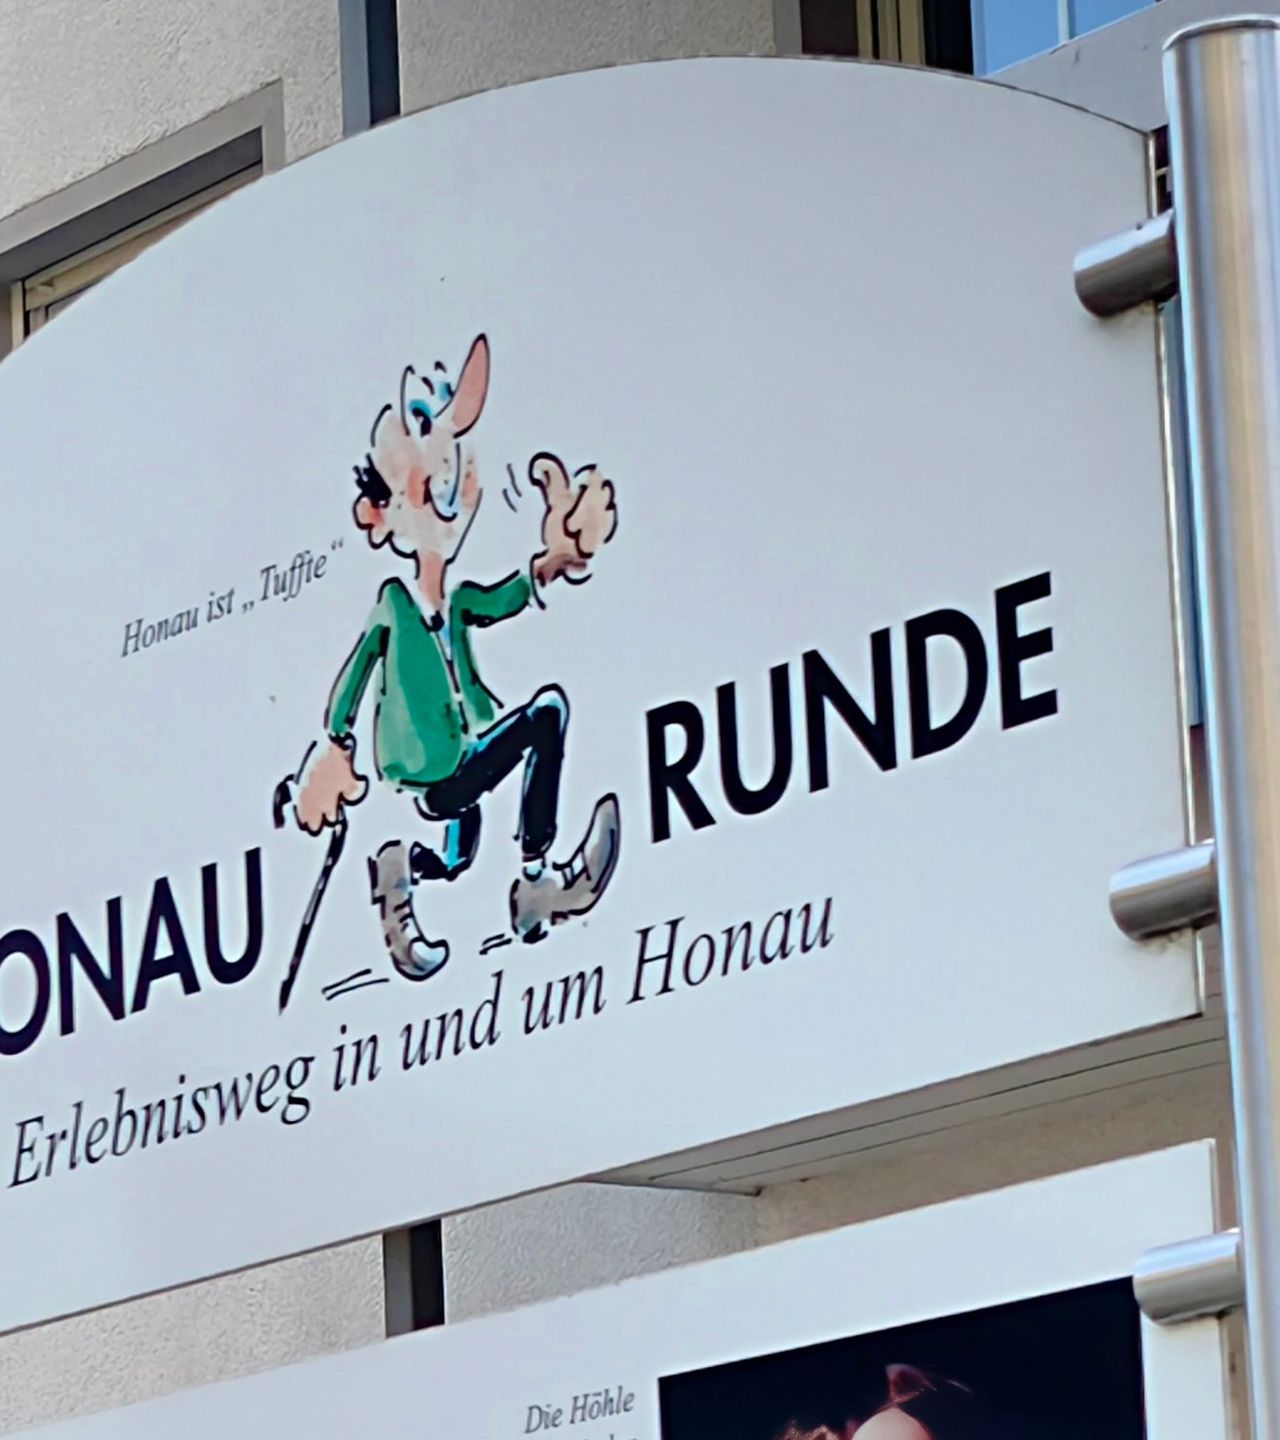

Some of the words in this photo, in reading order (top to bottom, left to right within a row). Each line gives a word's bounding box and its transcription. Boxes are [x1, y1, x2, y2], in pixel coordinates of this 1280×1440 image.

[121, 607, 199, 658] Honau
[206, 587, 235, 623] ist
[645, 571, 1061, 845] RUNDE
[8, 1053, 316, 1190] Erlebnisweg
[330, 1023, 381, 1093] in
[400, 970, 502, 1071] und
[521, 965, 608, 1038] um
[625, 894, 837, 1007] Honau
[524, 1403, 563, 1434] Die
[569, 1385, 635, 1426] Höhle
